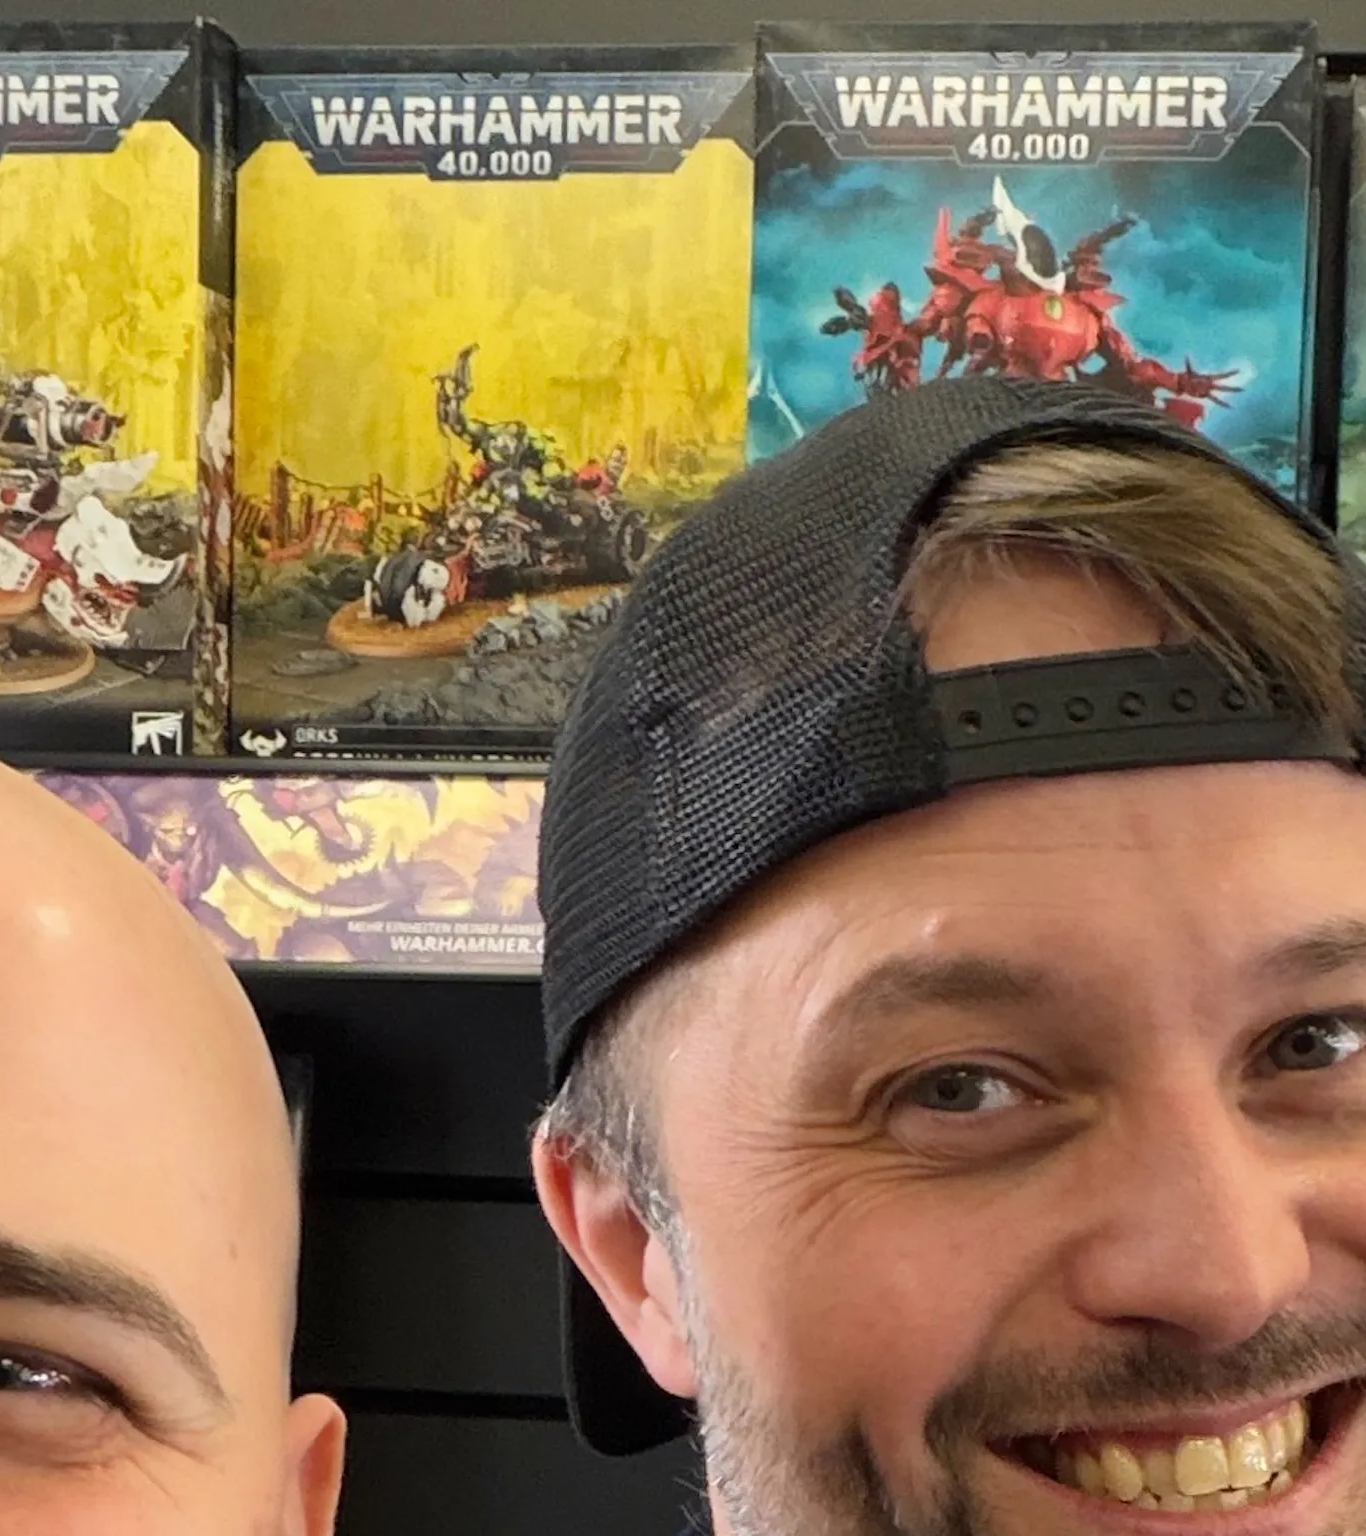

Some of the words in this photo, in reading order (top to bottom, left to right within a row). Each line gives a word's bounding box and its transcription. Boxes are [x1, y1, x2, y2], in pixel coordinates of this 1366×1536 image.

[310, 95, 683, 146] WARHAMMER
[836, 76, 1228, 128] WARHAMMER
[294, 727, 338, 744] ORKS
